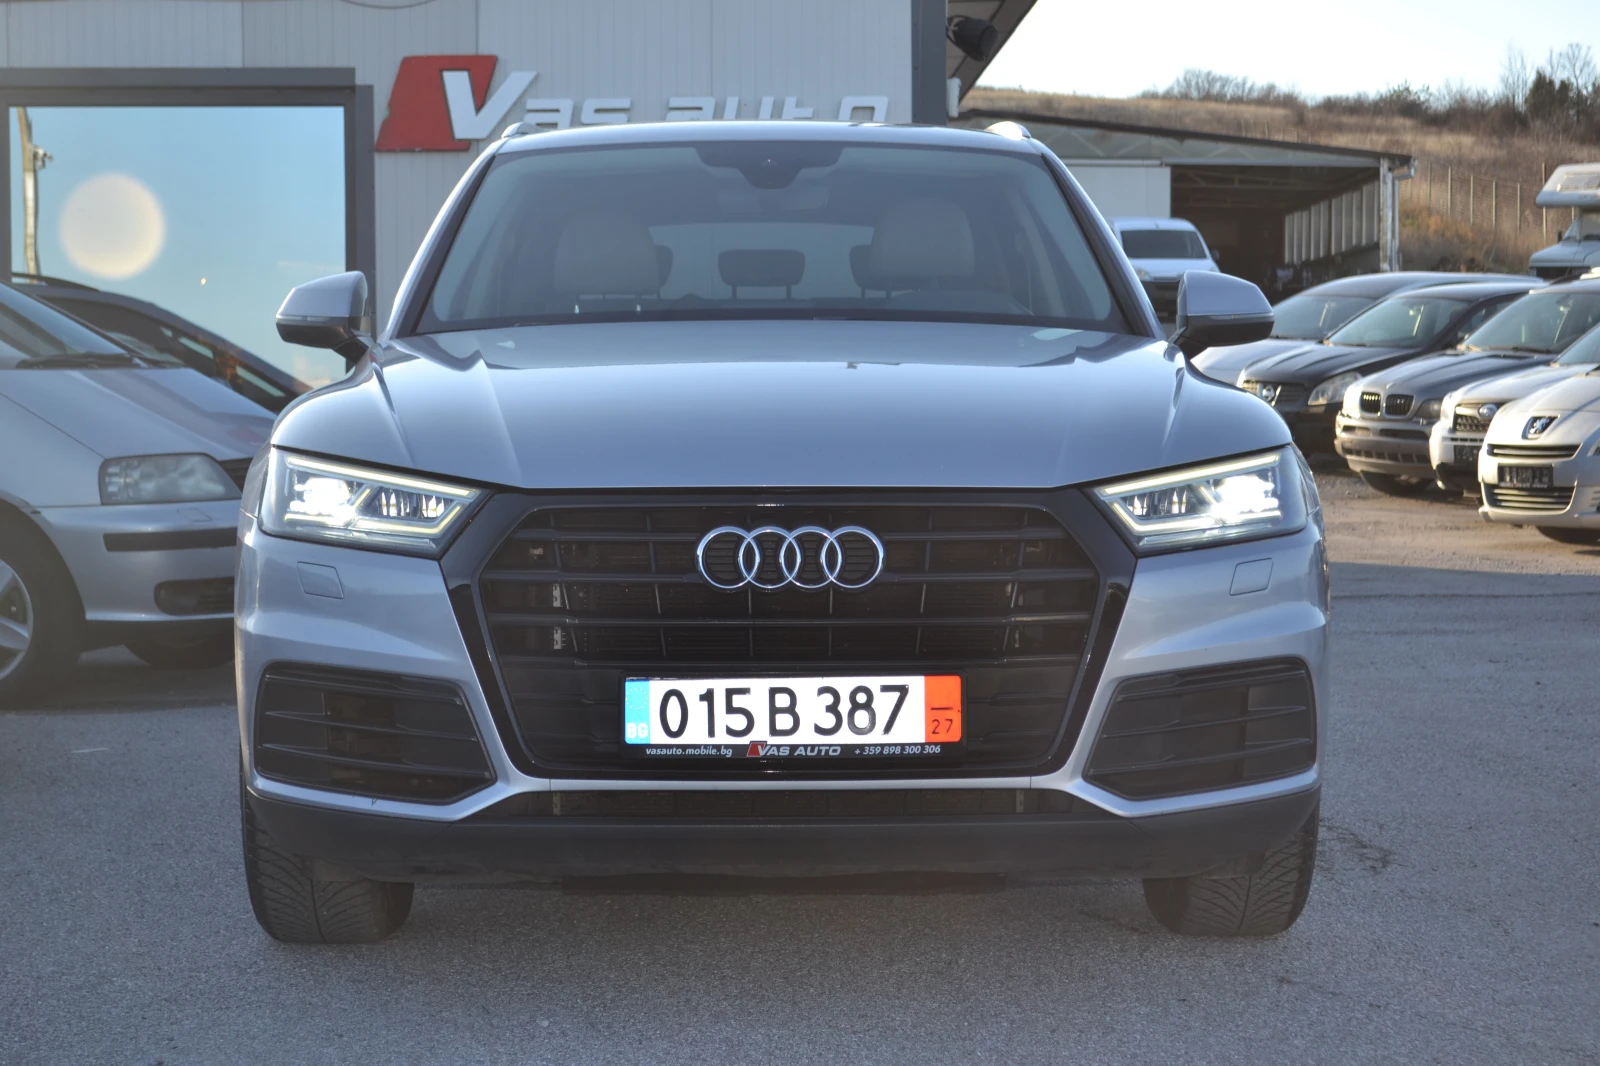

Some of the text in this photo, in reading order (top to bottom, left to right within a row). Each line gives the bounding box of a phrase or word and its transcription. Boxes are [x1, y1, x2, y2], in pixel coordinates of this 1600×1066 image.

[626, 722, 649, 739] BG
[931, 718, 954, 735] 27
[645, 745, 733, 758] vasauto.mobile.bg
[757, 745, 841, 756] VAS AUTO
